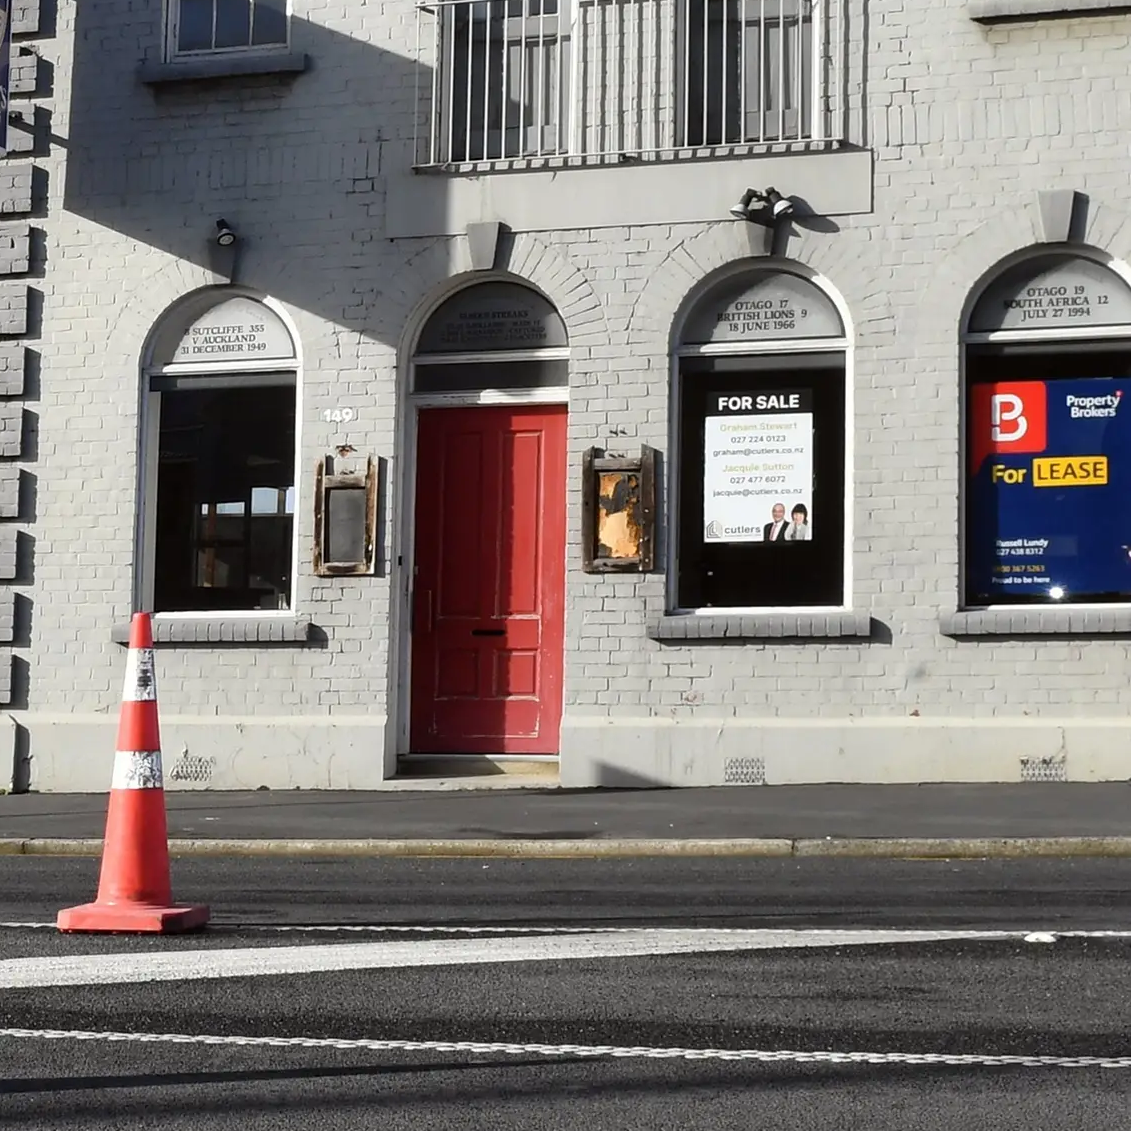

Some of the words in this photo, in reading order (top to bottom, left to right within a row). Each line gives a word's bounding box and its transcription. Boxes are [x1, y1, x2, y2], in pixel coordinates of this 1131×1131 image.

[1026, 286, 1067, 297] OTAGO
[1074, 285, 1085, 295] 19
[735, 300, 773, 311] OTAGO
[779, 299, 789, 309] 17
[1004, 299, 1043, 309] SOUTH
[1047, 296, 1090, 307] AFRICA
[1097, 295, 1109, 305] 12
[717, 311, 761, 322] BRITISH
[764, 309, 795, 320] LIONS
[801, 309, 808, 318] 9
[1021, 309, 1049, 322] JULY
[1052, 308, 1064, 318] 27
[1068, 307, 1091, 317] 1994
[192, 325, 244, 336] SUTCLIFFE
[249, 324, 265, 333] 355
[729, 322, 739, 332] 18
[741, 321, 770, 334] JUNE
[773, 320, 796, 330] 1966
[192, 336, 199, 345] V
[202, 334, 256, 344] AUCKLAND
[181, 346, 189, 355] 31
[192, 344, 244, 354] DECEMBER
[247, 342, 267, 352] 1949
[718, 396, 752, 411] FOR
[756, 394, 800, 409] SALE
[1066, 394, 1121, 407] Property
[323, 408, 353, 422] 149
[991, 393, 1028, 442] B
[1071, 406, 1117, 418] Brokers
[730, 436, 746, 444] 027
[749, 435, 764, 443] 224
[766, 434, 786, 442] 0123
[992, 464, 1027, 484] For
[1037, 461, 1105, 481] LEASE
[730, 476, 746, 484] 027
[724, 525, 762, 535] cutlers
[1024, 538, 1049, 549] Lundy
[1033, 575, 1051, 583] here
